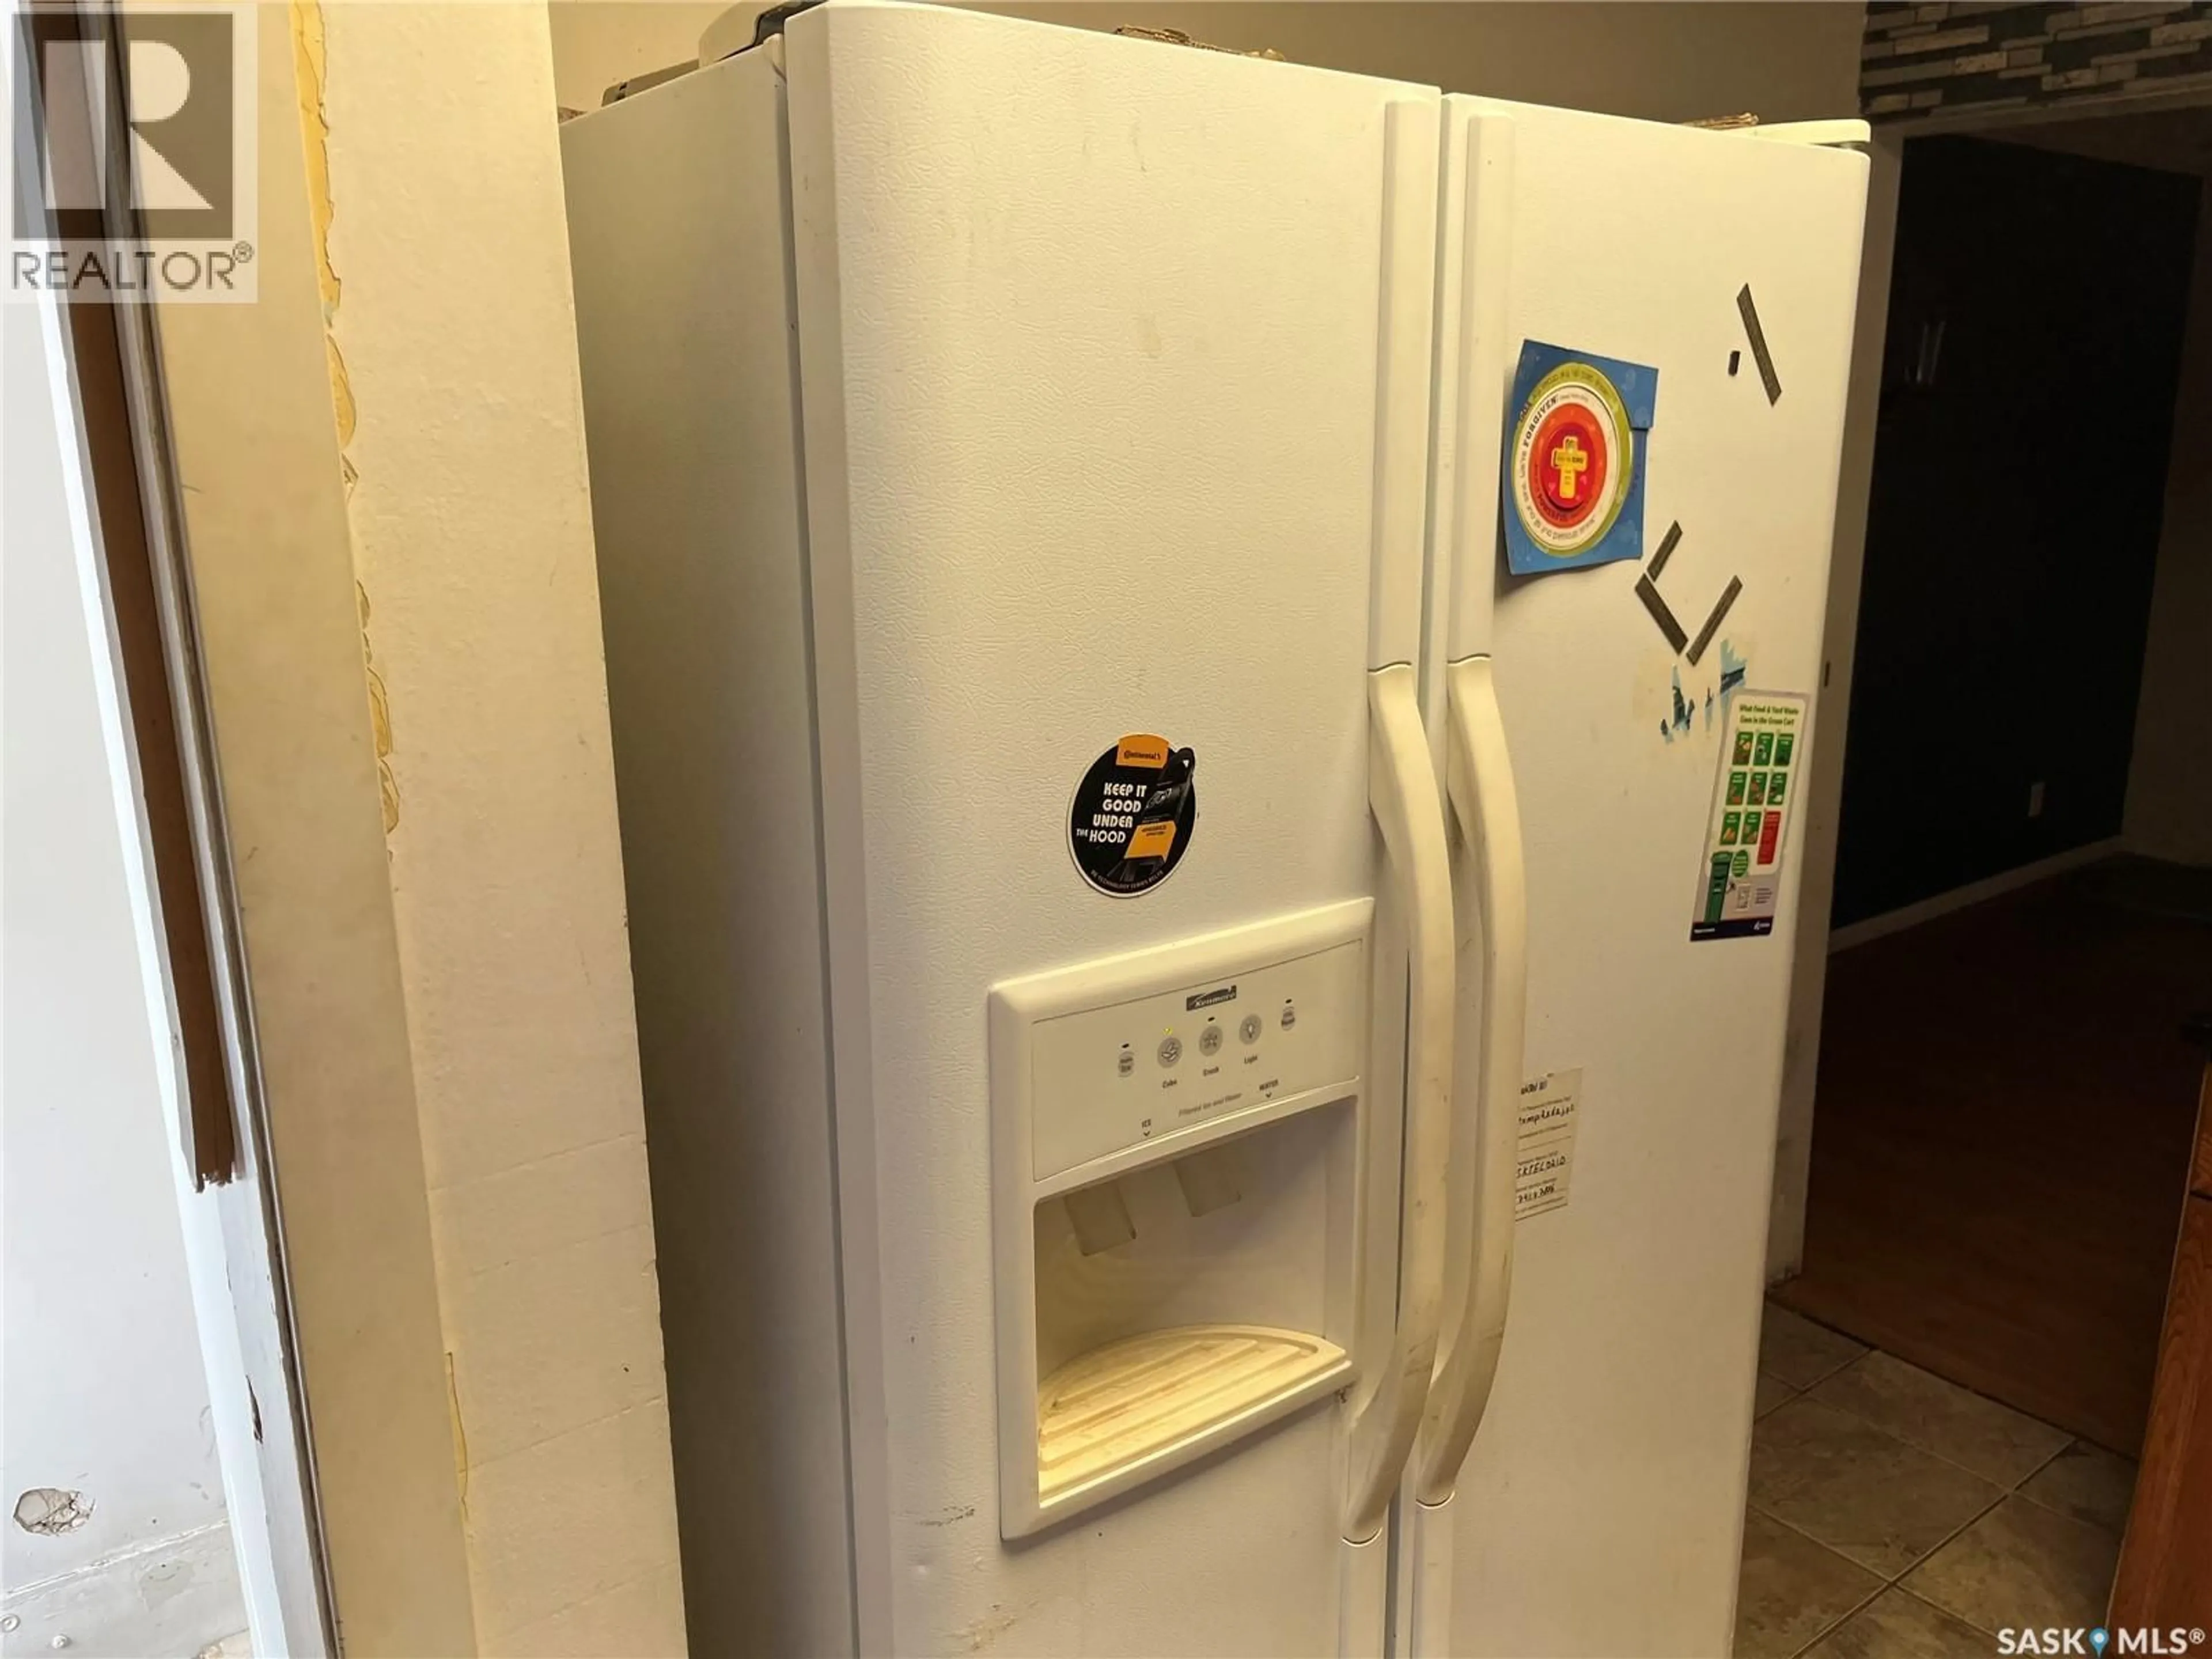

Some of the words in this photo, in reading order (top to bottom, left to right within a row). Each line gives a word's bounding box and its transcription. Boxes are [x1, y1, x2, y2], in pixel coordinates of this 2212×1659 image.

[1103, 782, 1134, 797] KEEP
[1136, 785, 1147, 797] IT
[1103, 798, 1142, 812] GOOD
[1093, 813, 1134, 828] UNDER
[1076, 828, 1088, 837] THE
[1089, 829, 1126, 843] HOOD
[1191, 991, 1236, 1008] Kenmore
